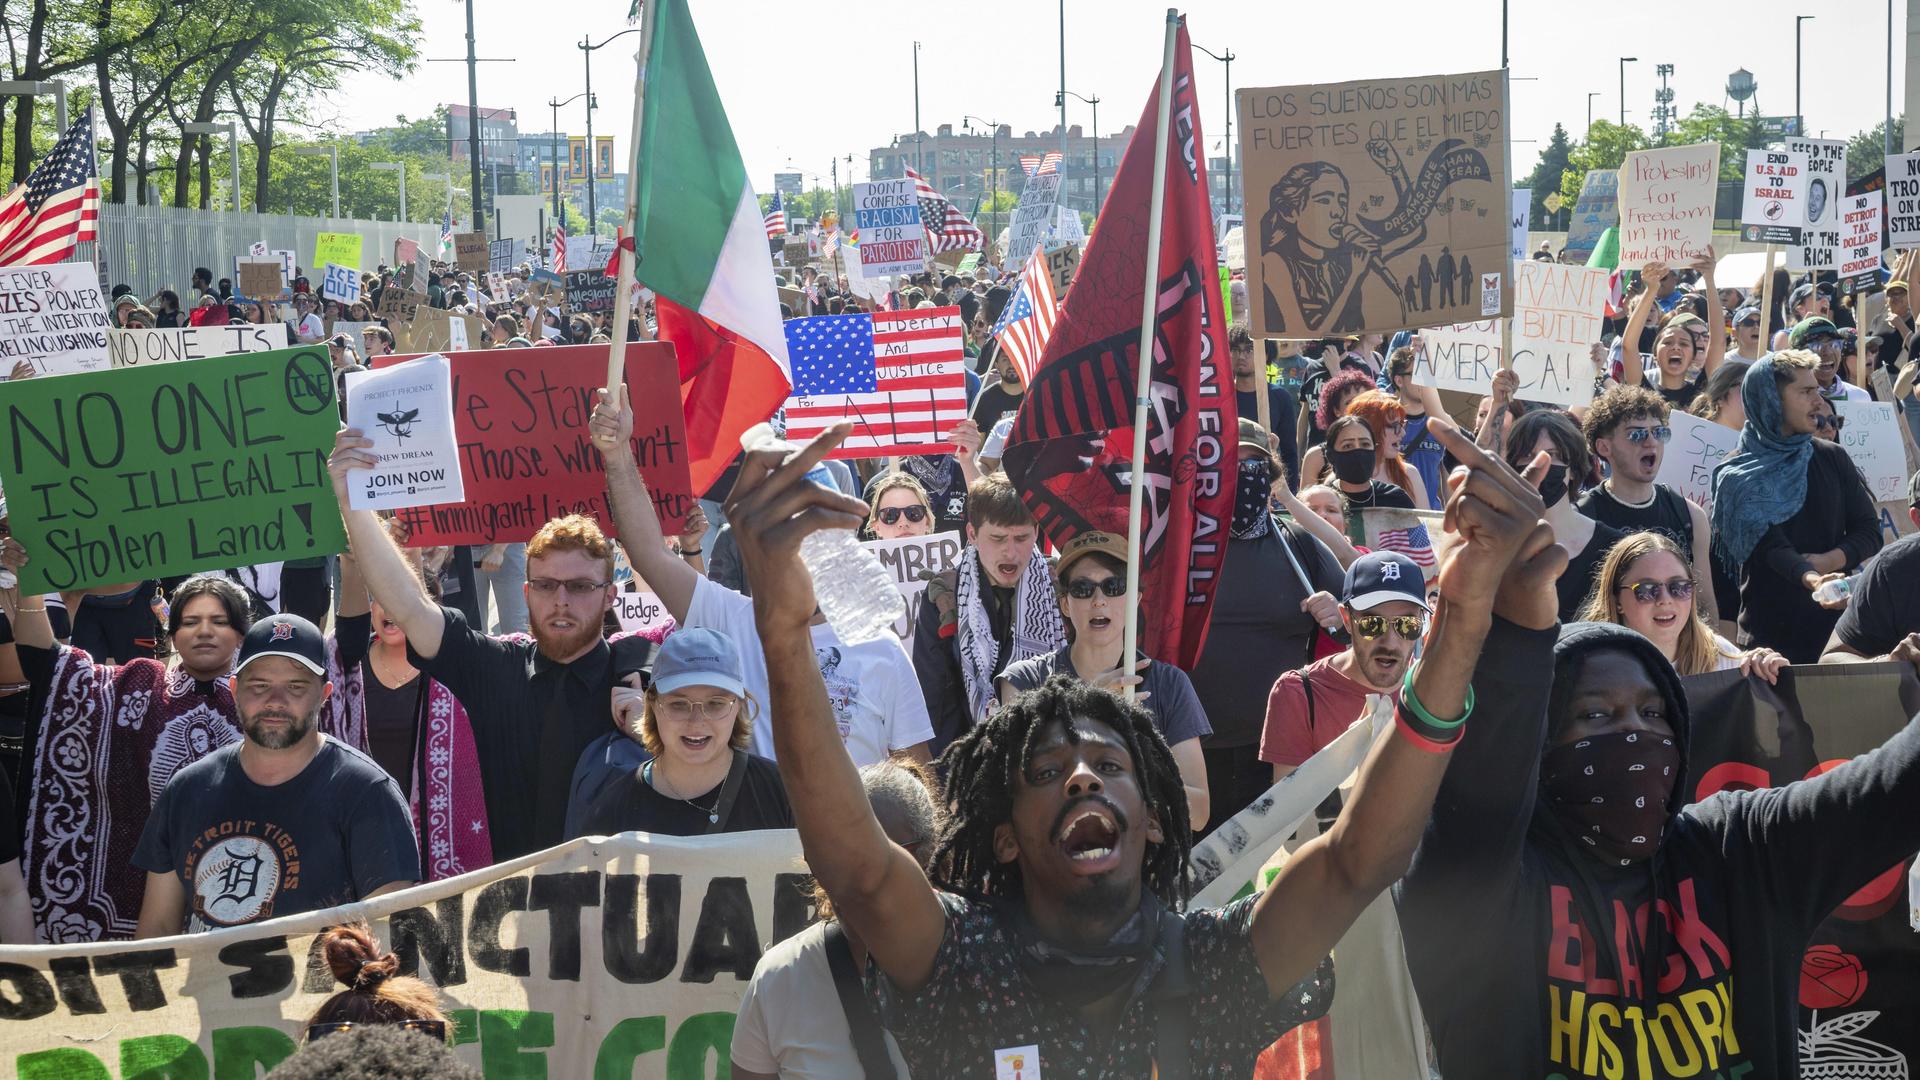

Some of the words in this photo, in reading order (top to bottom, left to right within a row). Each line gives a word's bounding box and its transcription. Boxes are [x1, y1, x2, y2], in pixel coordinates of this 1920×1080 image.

[1252, 95, 1297, 119] LOS
[1310, 86, 1398, 116] SUEÑOS
[1404, 84, 1446, 109] SON
[1453, 77, 1492, 102] MÁS
[1253, 122, 1359, 150] FUERTES
[1369, 119, 1408, 143] QUE
[1417, 116, 1439, 138] EL
[1443, 110, 1500, 135] MIEDO
[1767, 153, 1789, 164] END
[1823, 145, 1844, 160] THE
[1635, 156, 1711, 185] Protesting
[1756, 165, 1776, 175] U.S.
[1779, 166, 1798, 176] AID
[1808, 160, 1834, 173] EOPLE
[868, 180, 906, 196] DON'T
[1769, 177, 1784, 187] TO
[1890, 179, 1920, 197] TRO
[863, 194, 910, 209] CONFUSE
[1384, 191, 1424, 232] DREAMS
[1420, 160, 1438, 190] ARE
[1400, 171, 1444, 236] STRONGER
[1449, 166, 1481, 179] FEAR
[1643, 184, 1681, 204] for
[1755, 188, 1794, 200] ISRAEL
[1855, 197, 1867, 209] NO
[861, 207, 914, 227] RACISM
[1628, 206, 1711, 222] Freedom
[1844, 208, 1877, 224] DETROIT
[1898, 200, 1914, 214] ON
[875, 227, 902, 242] FOR
[1628, 227, 1646, 242] in
[1653, 228, 1689, 242] the
[1853, 222, 1869, 235] TAX
[1891, 216, 1920, 233] STRE
[1820, 231, 1839, 247] THE
[1843, 232, 1878, 249] DOLLARS
[862, 239, 922, 263] PATRIOTISM
[1621, 245, 1649, 261] land
[1804, 247, 1832, 265] RICH
[1853, 247, 1869, 259] FOR
[328, 265, 355, 285] ICE
[1842, 256, 1878, 274] GENOCIDE
[11, 270, 55, 291] EVER
[325, 279, 359, 300] OUT
[45, 288, 102, 311] POWER
[4, 316, 39, 335] THE
[41, 312, 110, 332] INTENTION
[874, 315, 951, 334] Liberty
[1523, 310, 1599, 345] BUILT
[109, 332, 139, 366] NO
[146, 329, 205, 361] ONE
[225, 327, 272, 355] IS
[884, 341, 909, 356] And
[877, 358, 945, 380] Justice
[291, 373, 328, 399] ICE
[364, 389, 396, 401] PROJECT
[397, 383, 434, 396] PHOENIX
[9, 391, 125, 475] NO
[151, 372, 285, 455] ONE
[798, 394, 815, 408] For
[841, 388, 951, 449] ALL
[1844, 430, 1870, 446] OF
[376, 454, 399, 463] NEW
[401, 450, 434, 460] DREAM
[460, 442, 548, 483] Those
[630, 425, 679, 468] an't
[1195, 409, 1221, 501] FOR
[366, 473, 403, 488] JOIN
[408, 468, 445, 484] NOW
[1690, 464, 1710, 486] Fo
[1878, 476, 1901, 491] OF
[32, 476, 99, 522] IS
[117, 453, 286, 513] ILLEGAL
[42, 524, 166, 590] Stolen
[868, 539, 958, 582] MBER
[1185, 514, 1220, 606] ALL!
[612, 596, 659, 625] Pledge
[184, 820, 257, 880] DETROIT
[264, 822, 301, 890] TIGERS
[1548, 877, 1732, 1000] BLACK
[1549, 976, 1741, 1080] HISTORY
